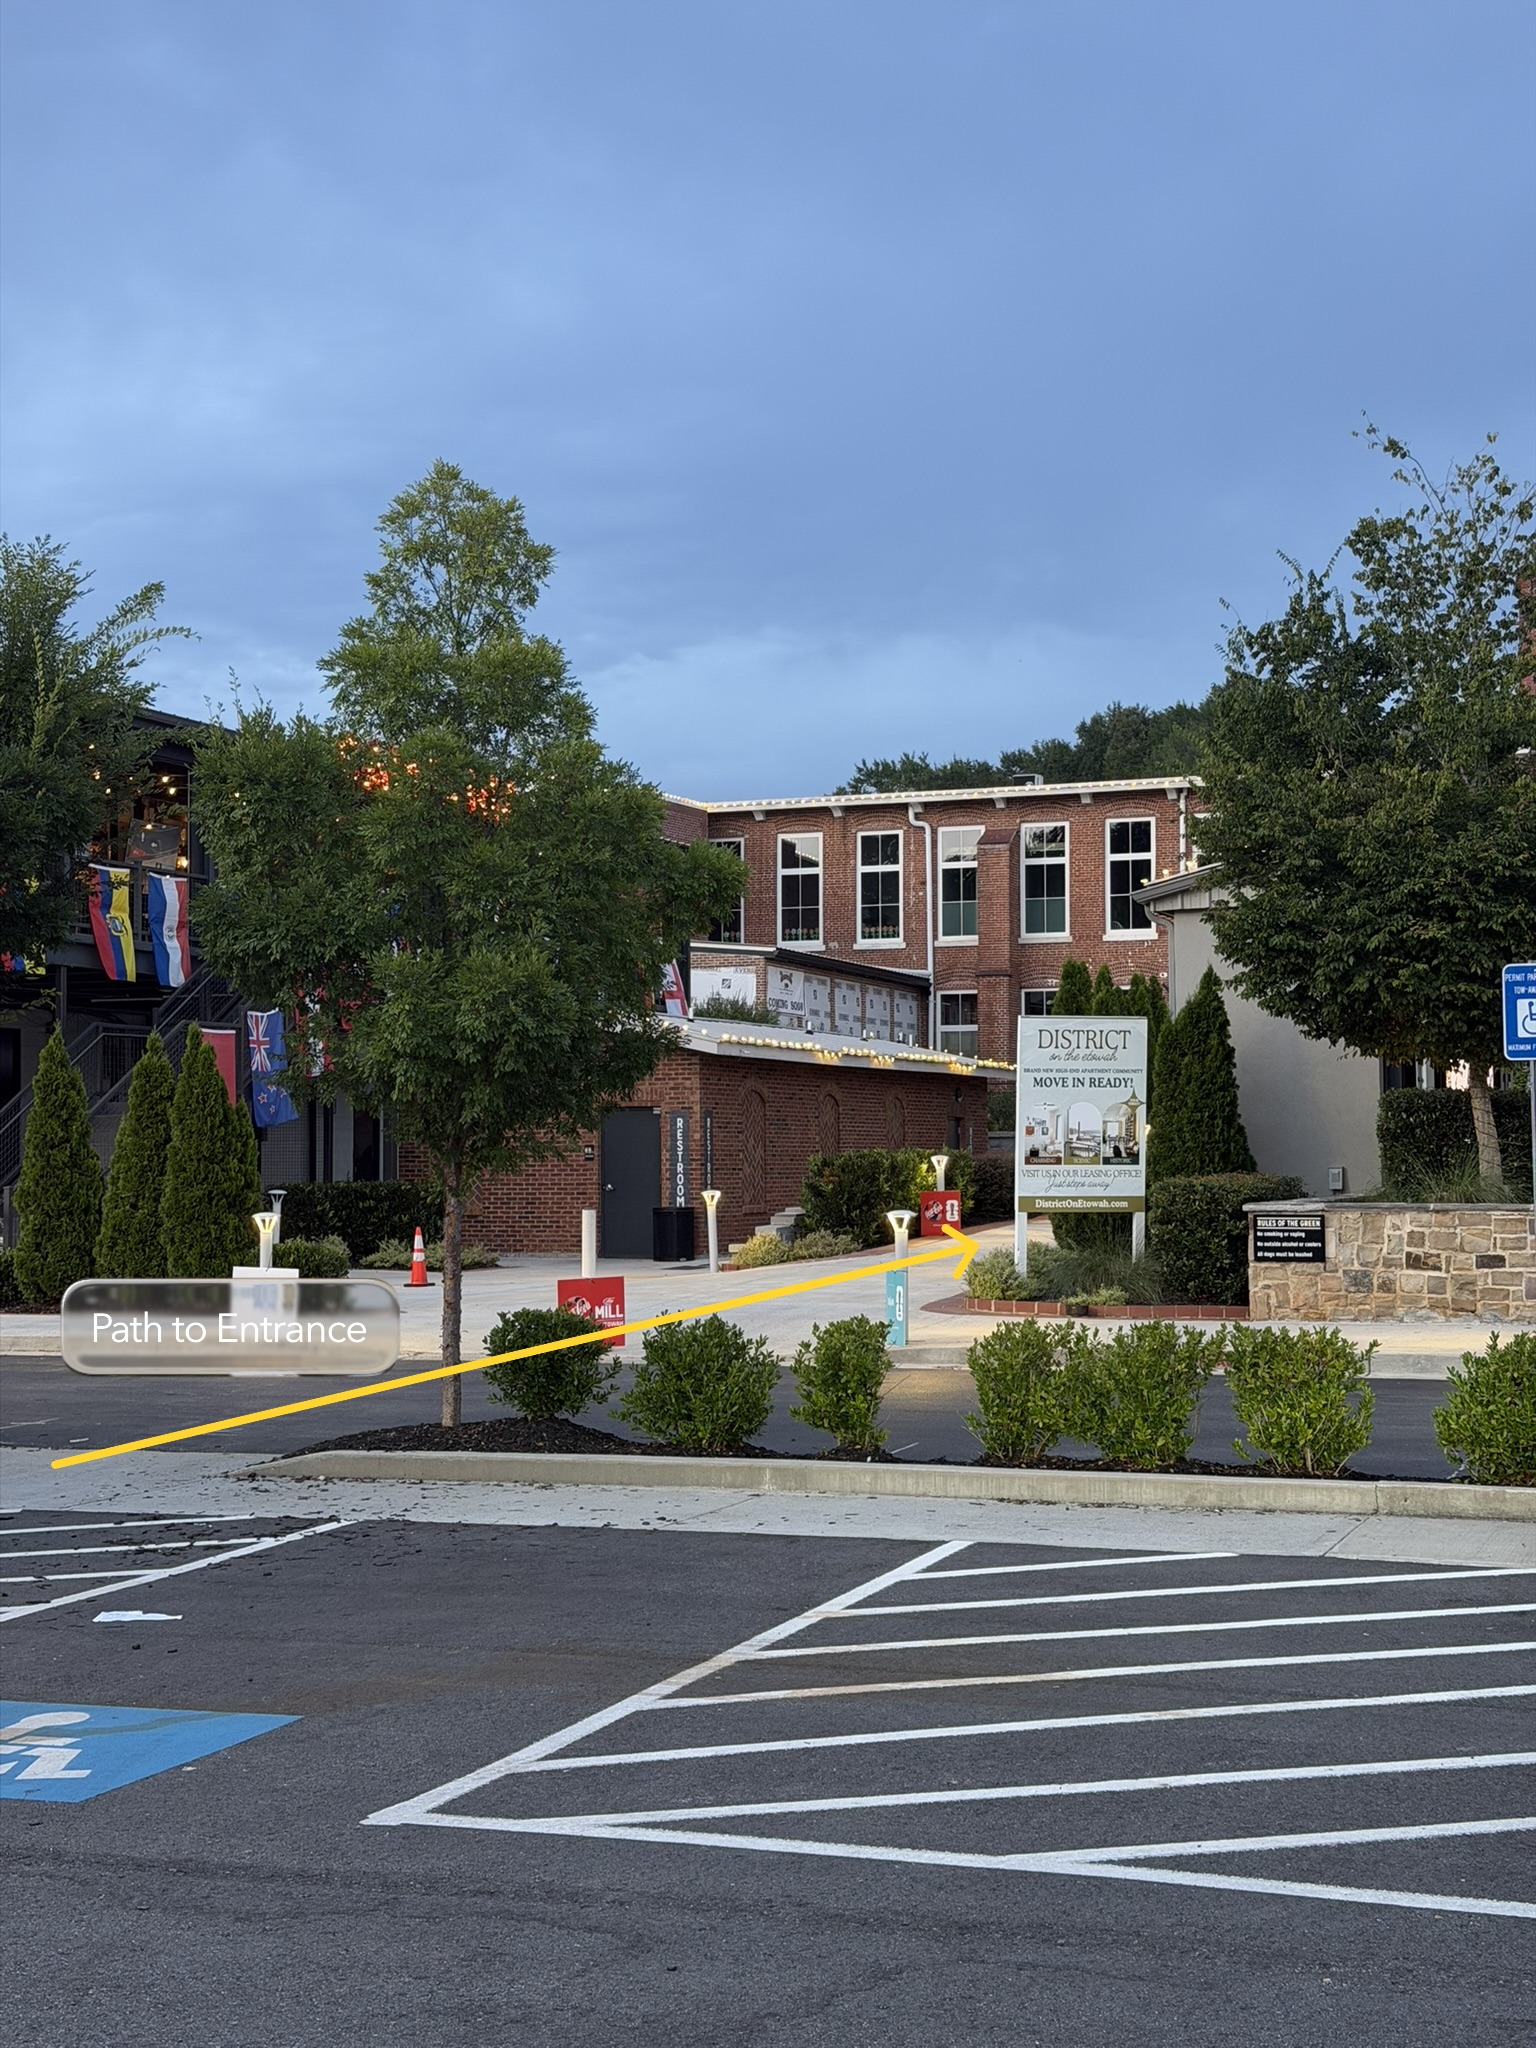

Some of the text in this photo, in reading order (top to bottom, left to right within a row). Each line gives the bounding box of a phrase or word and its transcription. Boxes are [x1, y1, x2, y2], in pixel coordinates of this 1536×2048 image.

[1505, 974, 1525, 982] PERMIT
[768, 997, 804, 1012] COMING SOON
[1038, 1029, 1131, 1050] DISTRICT
[1048, 1047, 1118, 1062] on the etowah
[1033, 1077, 1134, 1088] MOVE IN READY!
[676, 1117, 685, 1207] RESTROOM
[1021, 1169, 1142, 1178] VISIT US IN OUR LEASING OFFICE!
[1035, 1199, 1128, 1208] DistrictOnEtowah.com
[594, 1304, 624, 1319] MILL
